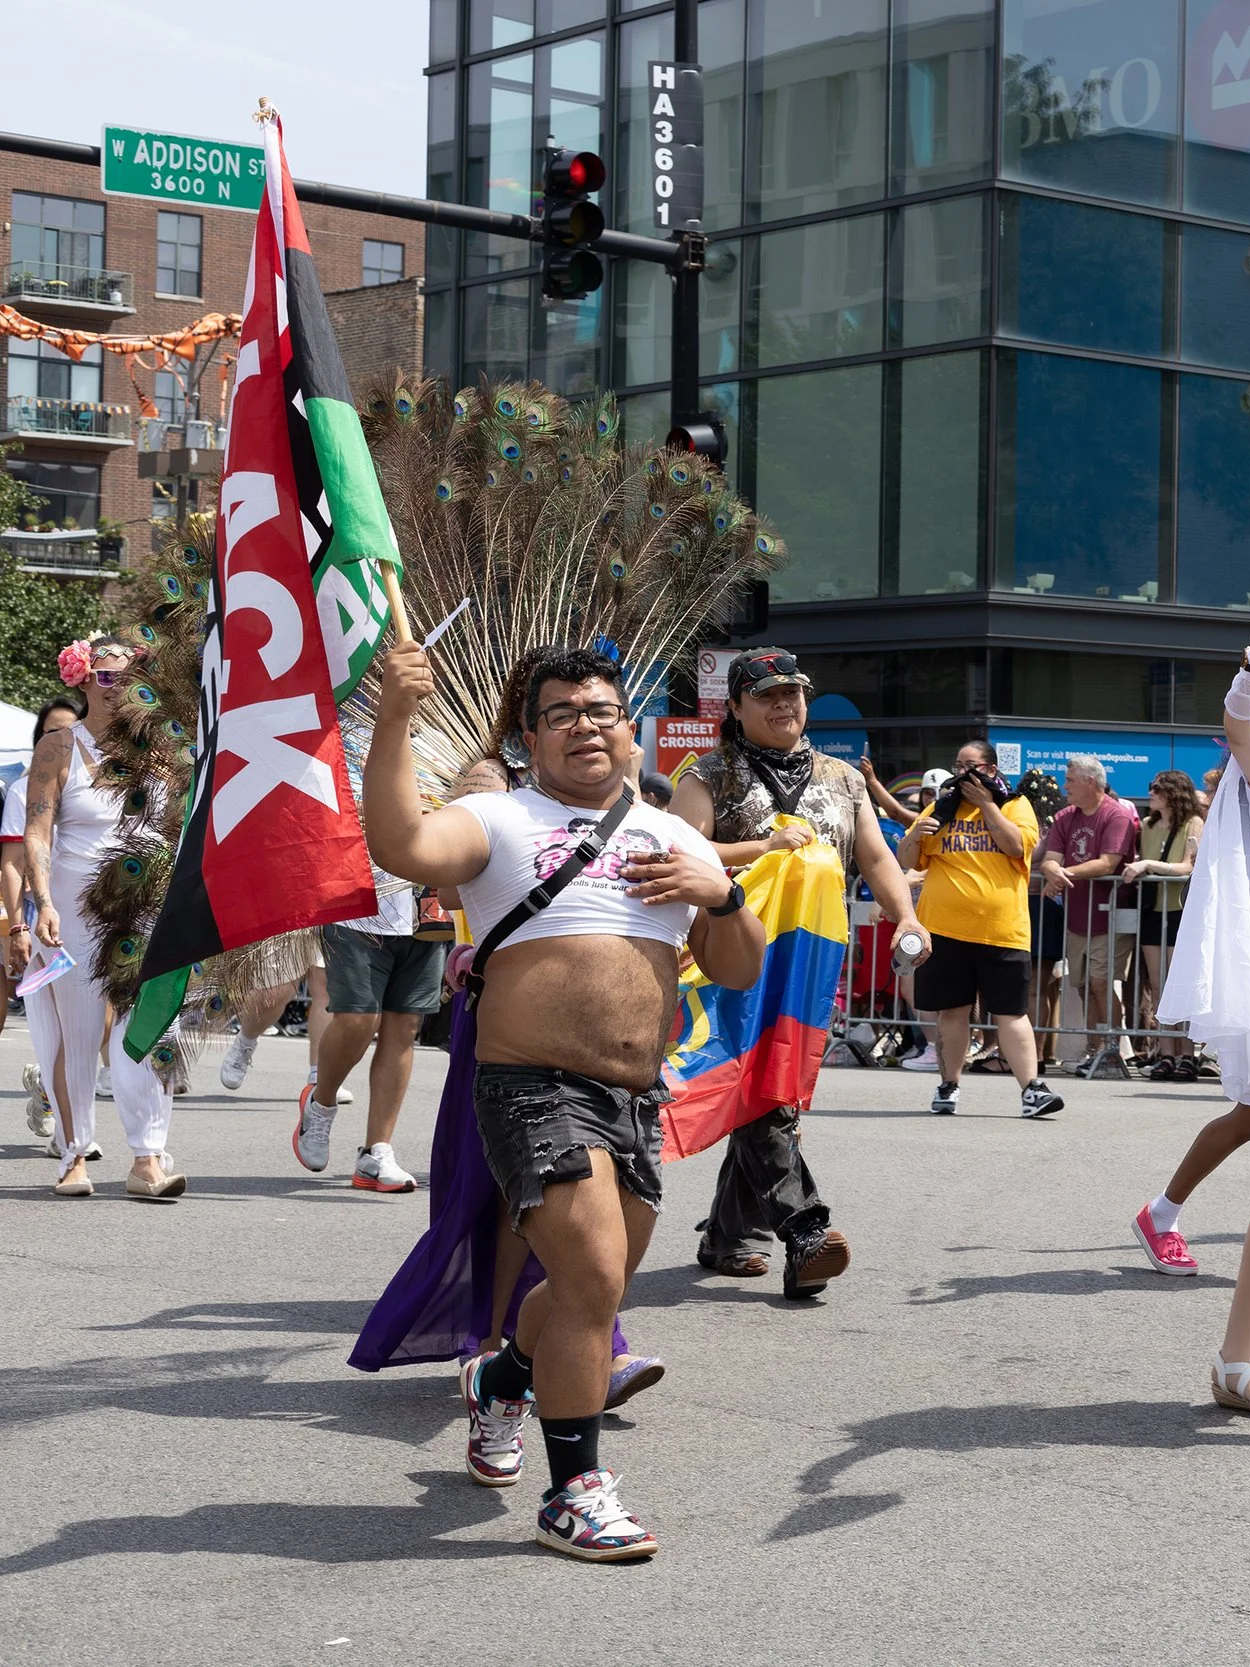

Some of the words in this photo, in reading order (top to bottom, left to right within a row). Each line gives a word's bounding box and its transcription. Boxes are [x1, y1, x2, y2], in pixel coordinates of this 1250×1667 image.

[652, 65, 676, 226] HA3601
[112, 139, 125, 157] W
[133, 139, 241, 178] ADDISON
[248, 158, 266, 177] ST
[151, 172, 205, 195] 3600
[218, 181, 231, 200] N
[666, 723, 715, 734] STREET
[1026, 750, 1042, 759] Scan
[1051, 750, 1065, 760] visit
[947, 819, 989, 834] PARA
[941, 834, 1003, 854] MARSHA
[591, 881, 608, 889] just
